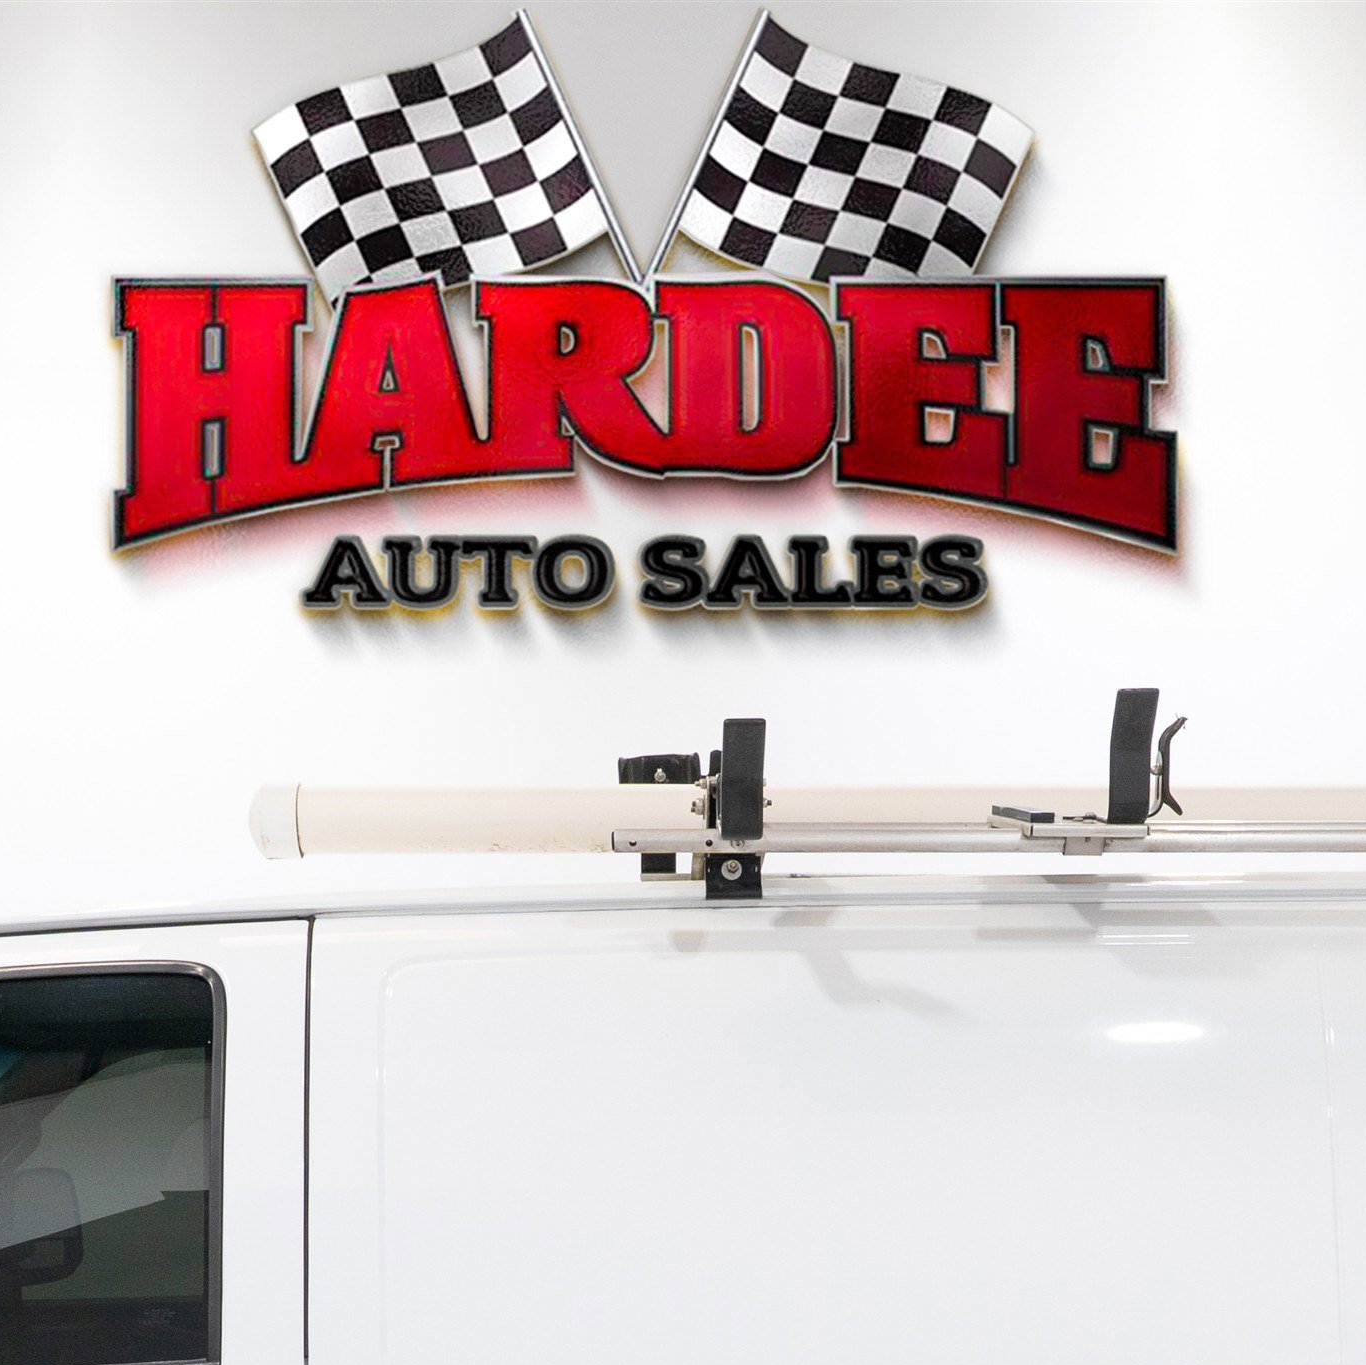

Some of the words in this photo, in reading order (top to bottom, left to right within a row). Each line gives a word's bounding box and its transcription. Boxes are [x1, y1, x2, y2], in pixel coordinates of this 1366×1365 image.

[111, 276, 1179, 552] HARDEE
[303, 535, 616, 611] AUTO
[641, 535, 988, 611] SALES
